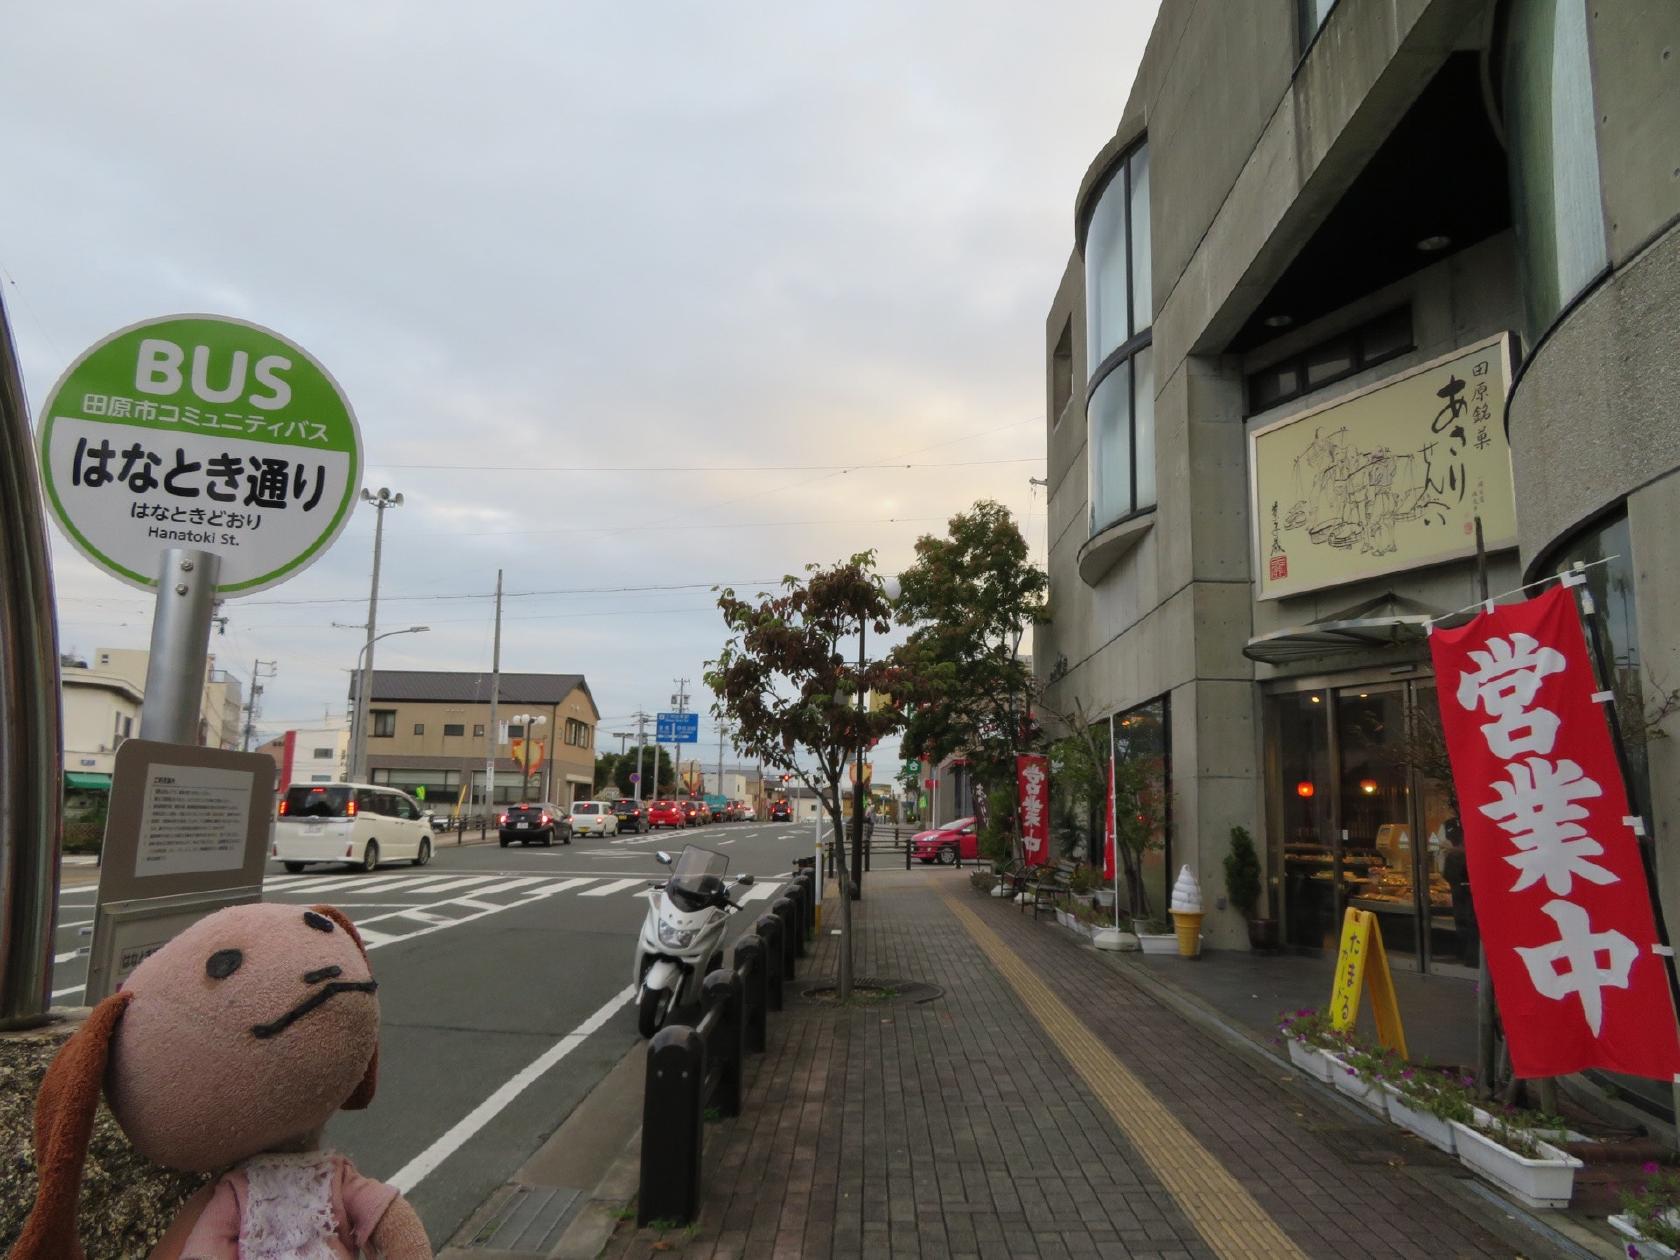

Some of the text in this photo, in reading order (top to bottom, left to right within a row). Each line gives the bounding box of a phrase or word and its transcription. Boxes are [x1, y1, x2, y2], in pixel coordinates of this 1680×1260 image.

[134, 338, 292, 410] BUS
[1471, 360, 1491, 450] 田原銘菓
[83, 393, 329, 443] 田原市コミュニティバス
[1431, 375, 1469, 503] あさり
[72, 437, 326, 512] はなとき通り
[131, 501, 261, 530] はなときどおり
[148, 526, 240, 546] Hanatoki St.
[1022, 764, 1045, 862] 営業中
[1456, 632, 1640, 1039] 営業中
